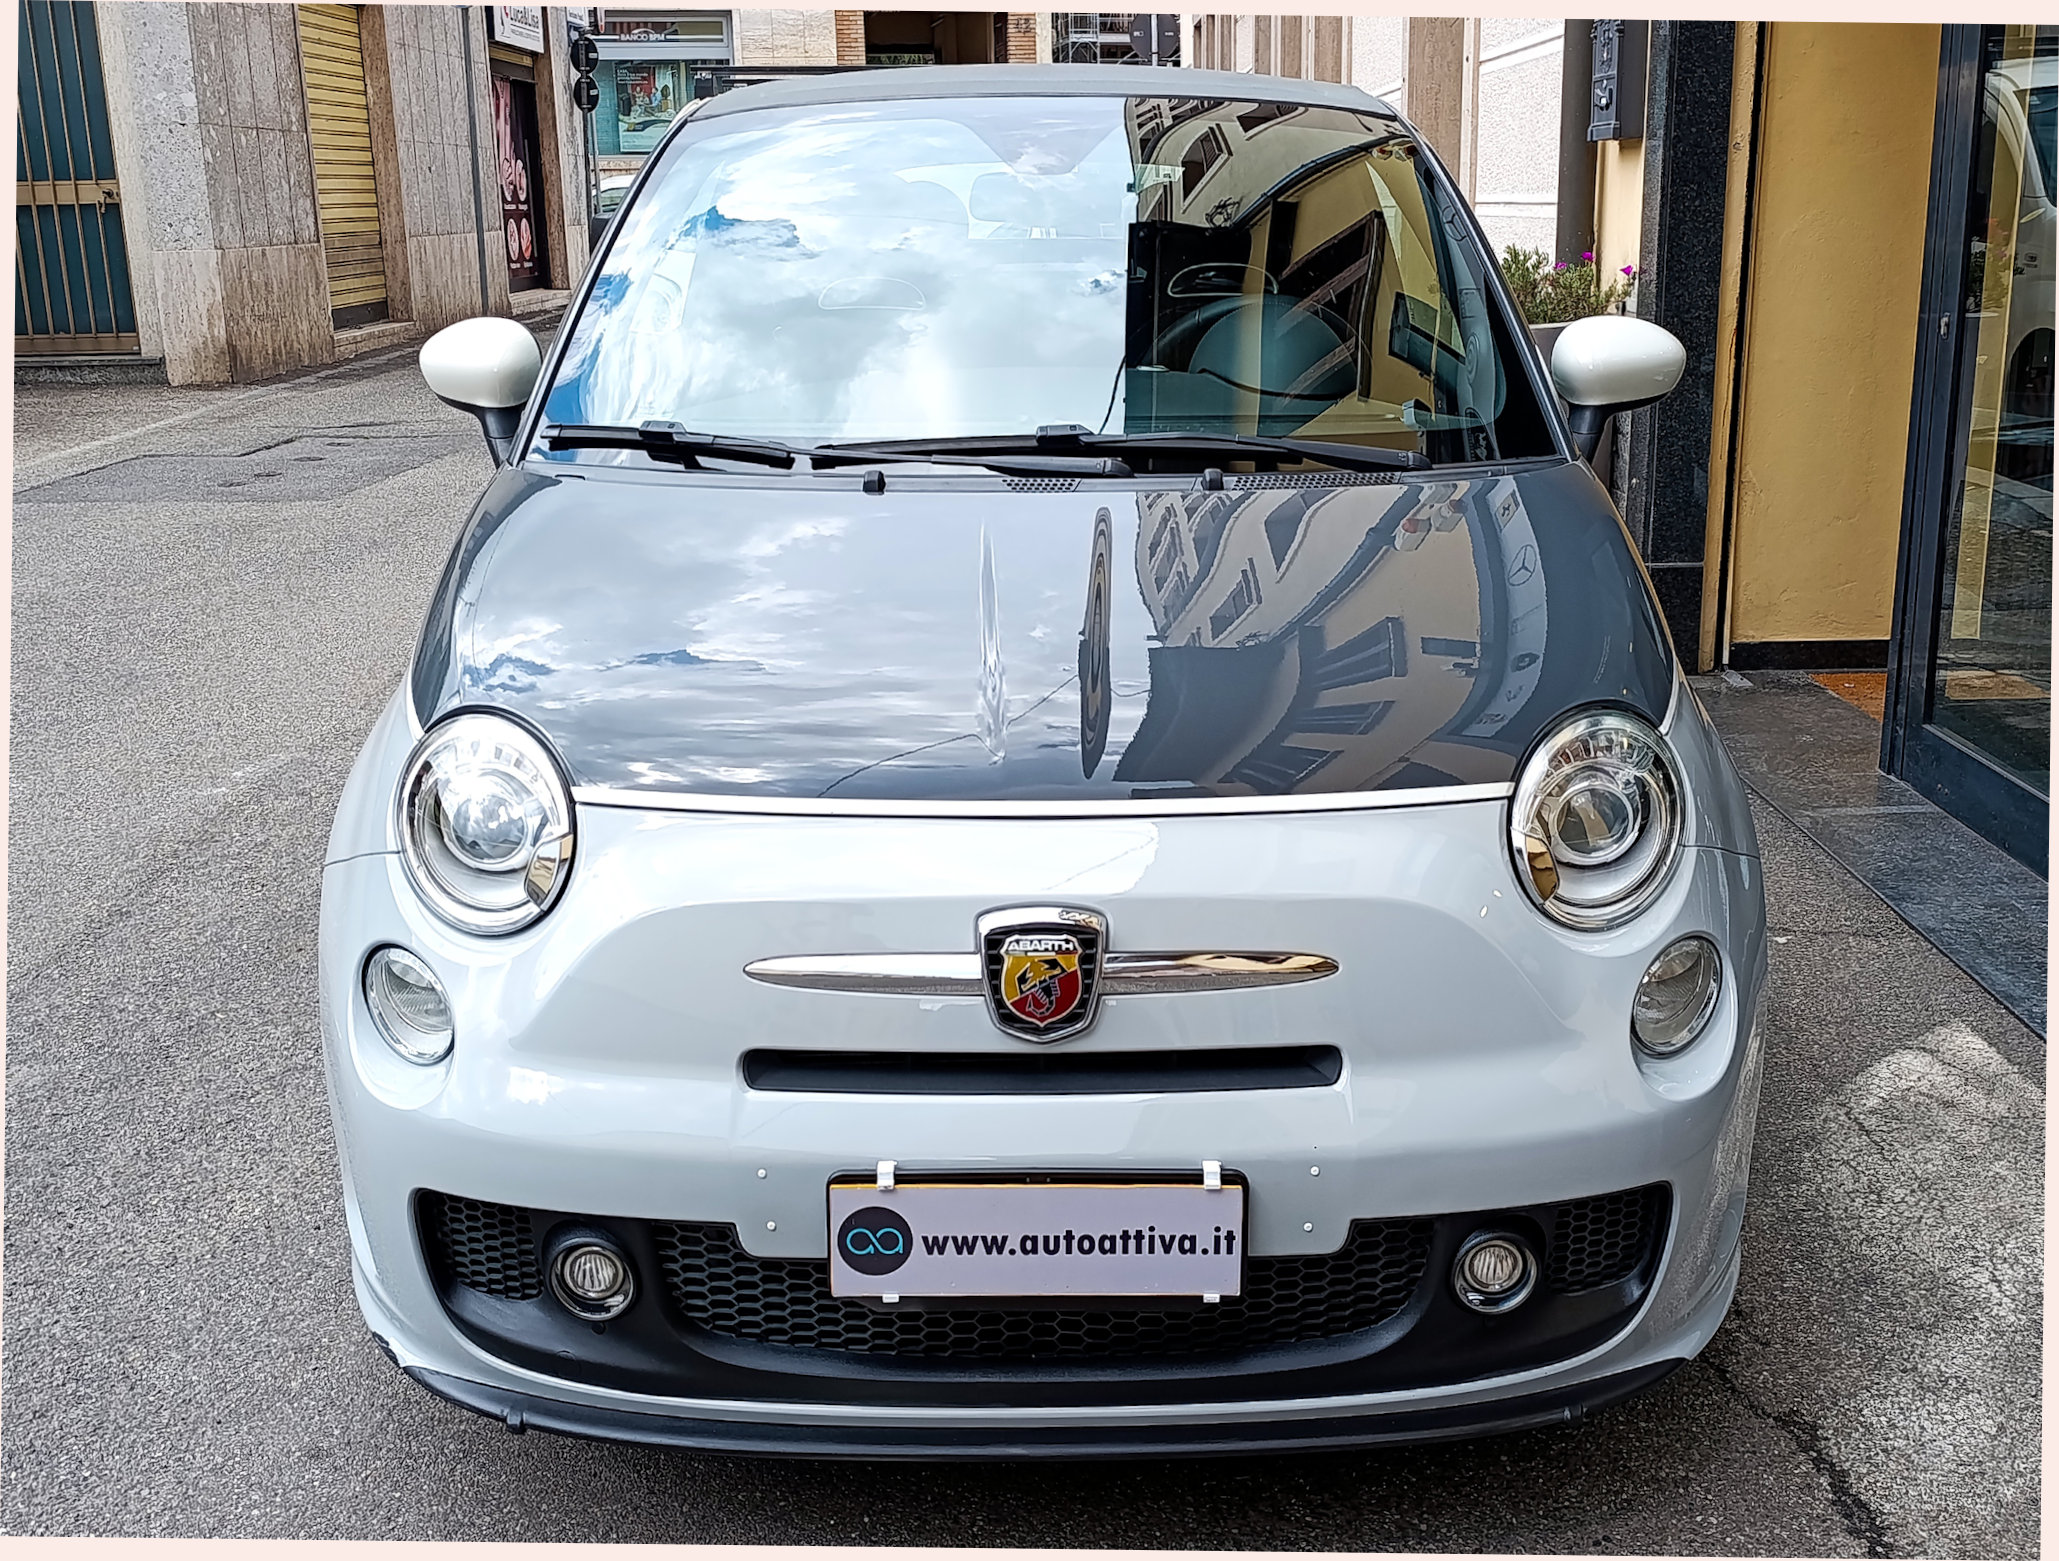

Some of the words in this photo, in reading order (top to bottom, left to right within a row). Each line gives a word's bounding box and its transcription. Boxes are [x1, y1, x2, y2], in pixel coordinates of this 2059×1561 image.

[620, 33, 648, 41] BANCO
[649, 33, 665, 41] BPM
[1007, 940, 1074, 951] ABARTH
[921, 1225, 1237, 1256] www.autoattiva.it
